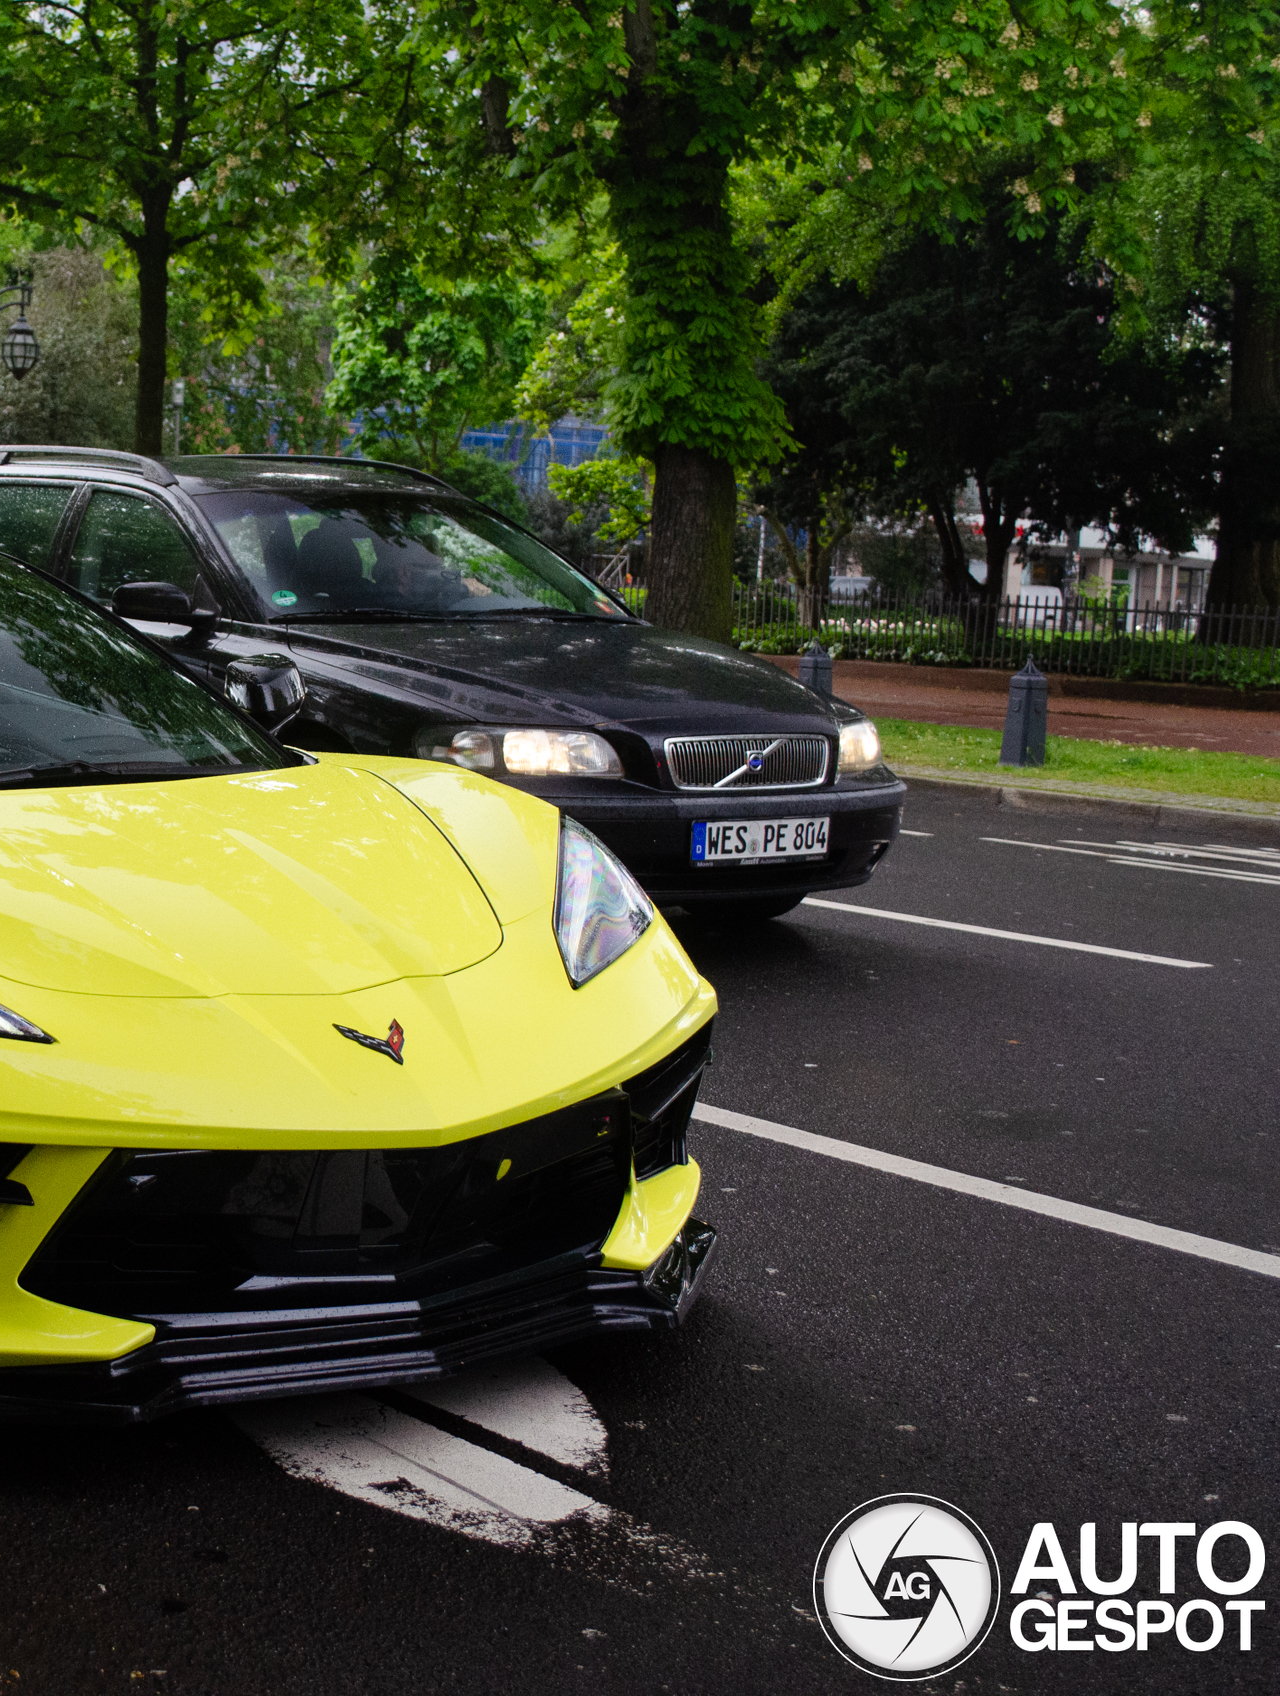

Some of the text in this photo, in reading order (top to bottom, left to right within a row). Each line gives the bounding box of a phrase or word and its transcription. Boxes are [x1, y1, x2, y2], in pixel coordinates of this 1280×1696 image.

[696, 844, 702, 854] D
[708, 821, 826, 855] WES PE 804
